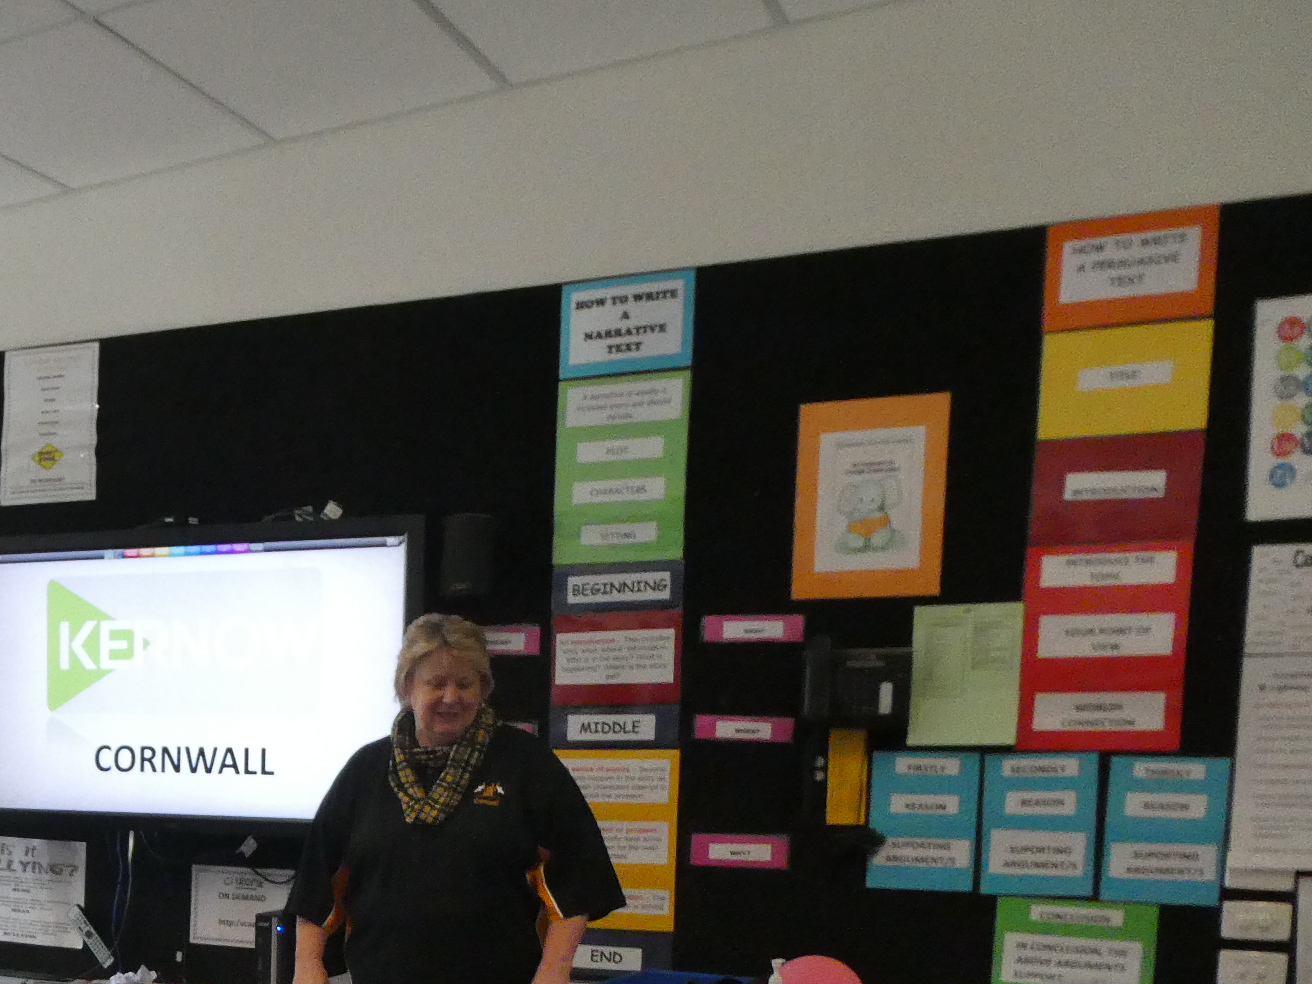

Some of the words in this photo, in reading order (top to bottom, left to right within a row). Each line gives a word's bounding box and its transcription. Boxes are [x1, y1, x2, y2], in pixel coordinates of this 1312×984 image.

[1115, 238, 1134, 249] TO
[1140, 231, 1188, 247] WRITE
[574, 297, 607, 310] HOW
[610, 295, 629, 306] TO
[632, 288, 679, 302] WRITE
[620, 310, 631, 321] A
[583, 322, 667, 341] NARRATIVE
[606, 341, 642, 355] TEXT
[571, 578, 669, 598] BEGINNING
[59, 616, 323, 671] KERNOW
[579, 719, 641, 735] MIDDLE
[94, 744, 275, 776] CORNWALL
[590, 949, 623, 965] END
